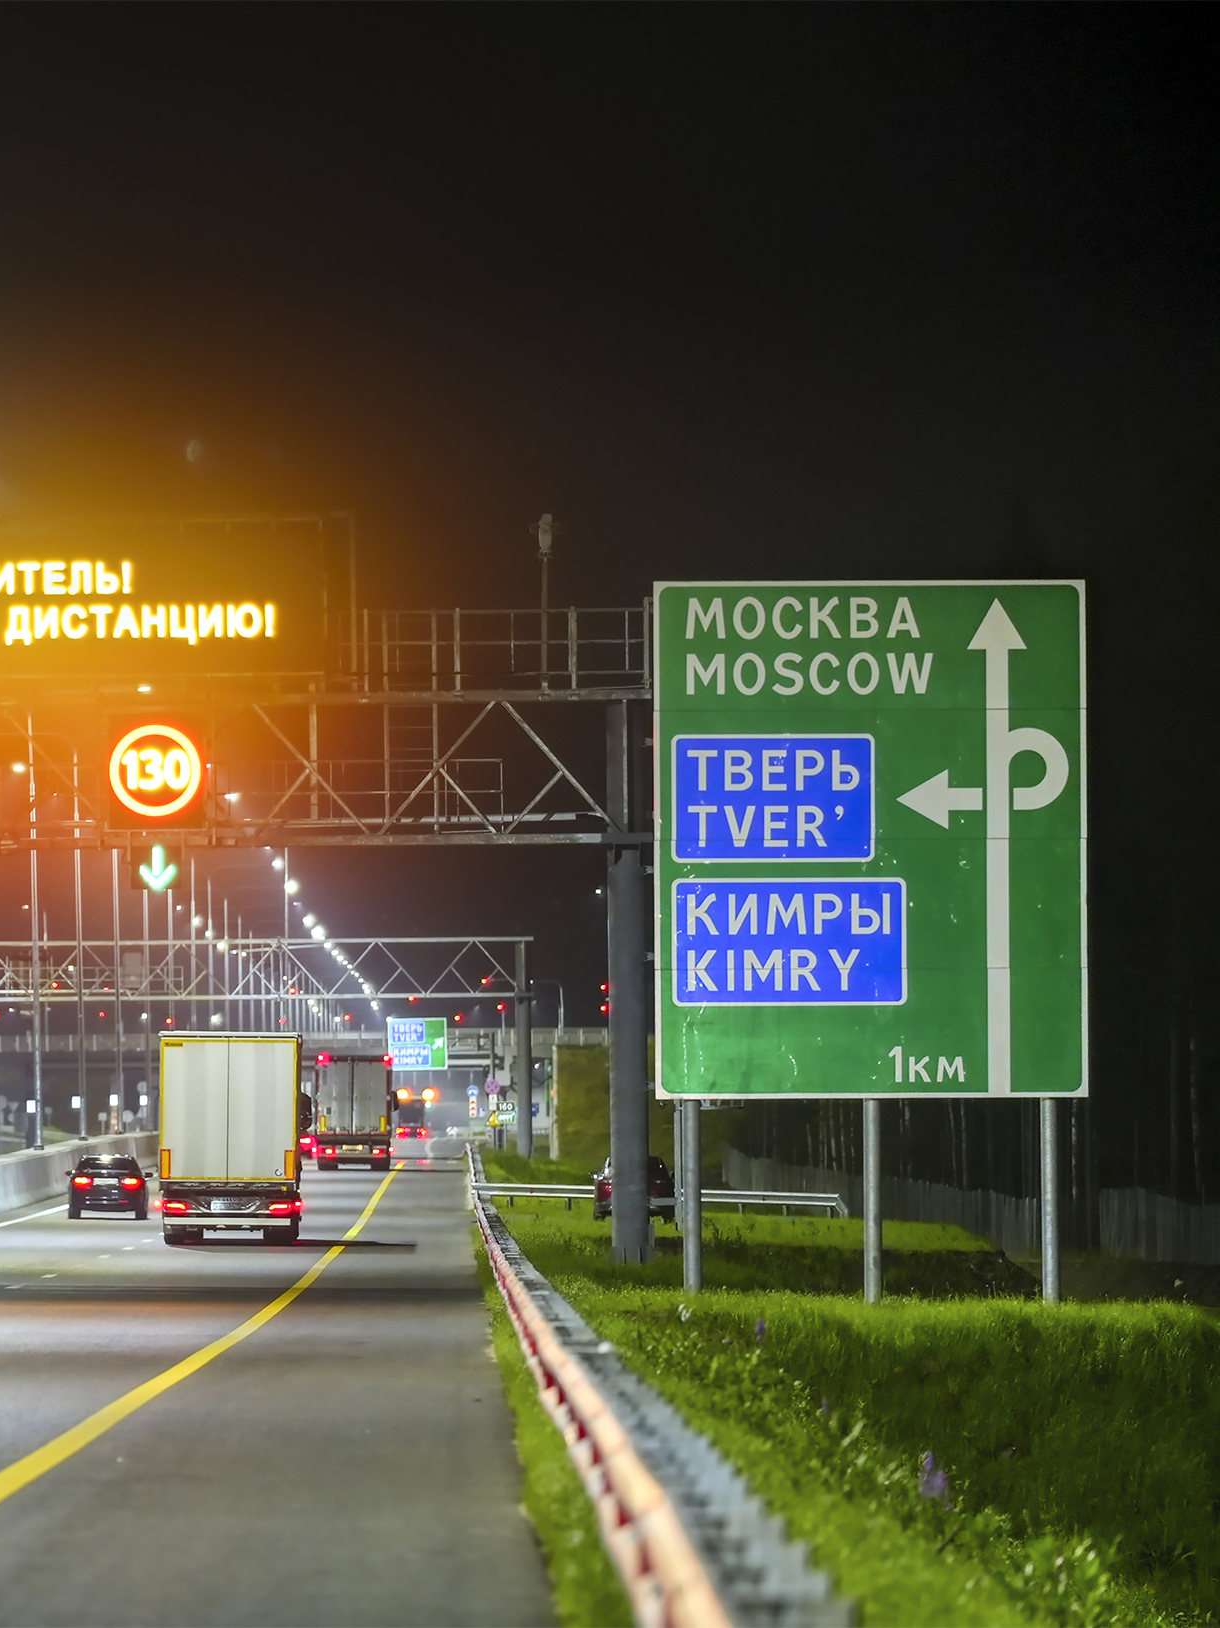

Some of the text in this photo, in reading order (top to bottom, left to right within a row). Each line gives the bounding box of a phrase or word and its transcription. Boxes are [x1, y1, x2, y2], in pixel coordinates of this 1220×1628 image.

[4, 603, 275, 646] ДИСТАНЦИЮ!
[685, 597, 921, 640] МОСКВА
[686, 652, 934, 696] MOSCOW
[120, 748, 191, 791] 130
[687, 749, 861, 792] ТВЕРЬ
[688, 892, 892, 936] КИМРЫ
[688, 948, 861, 992] KIMRY
